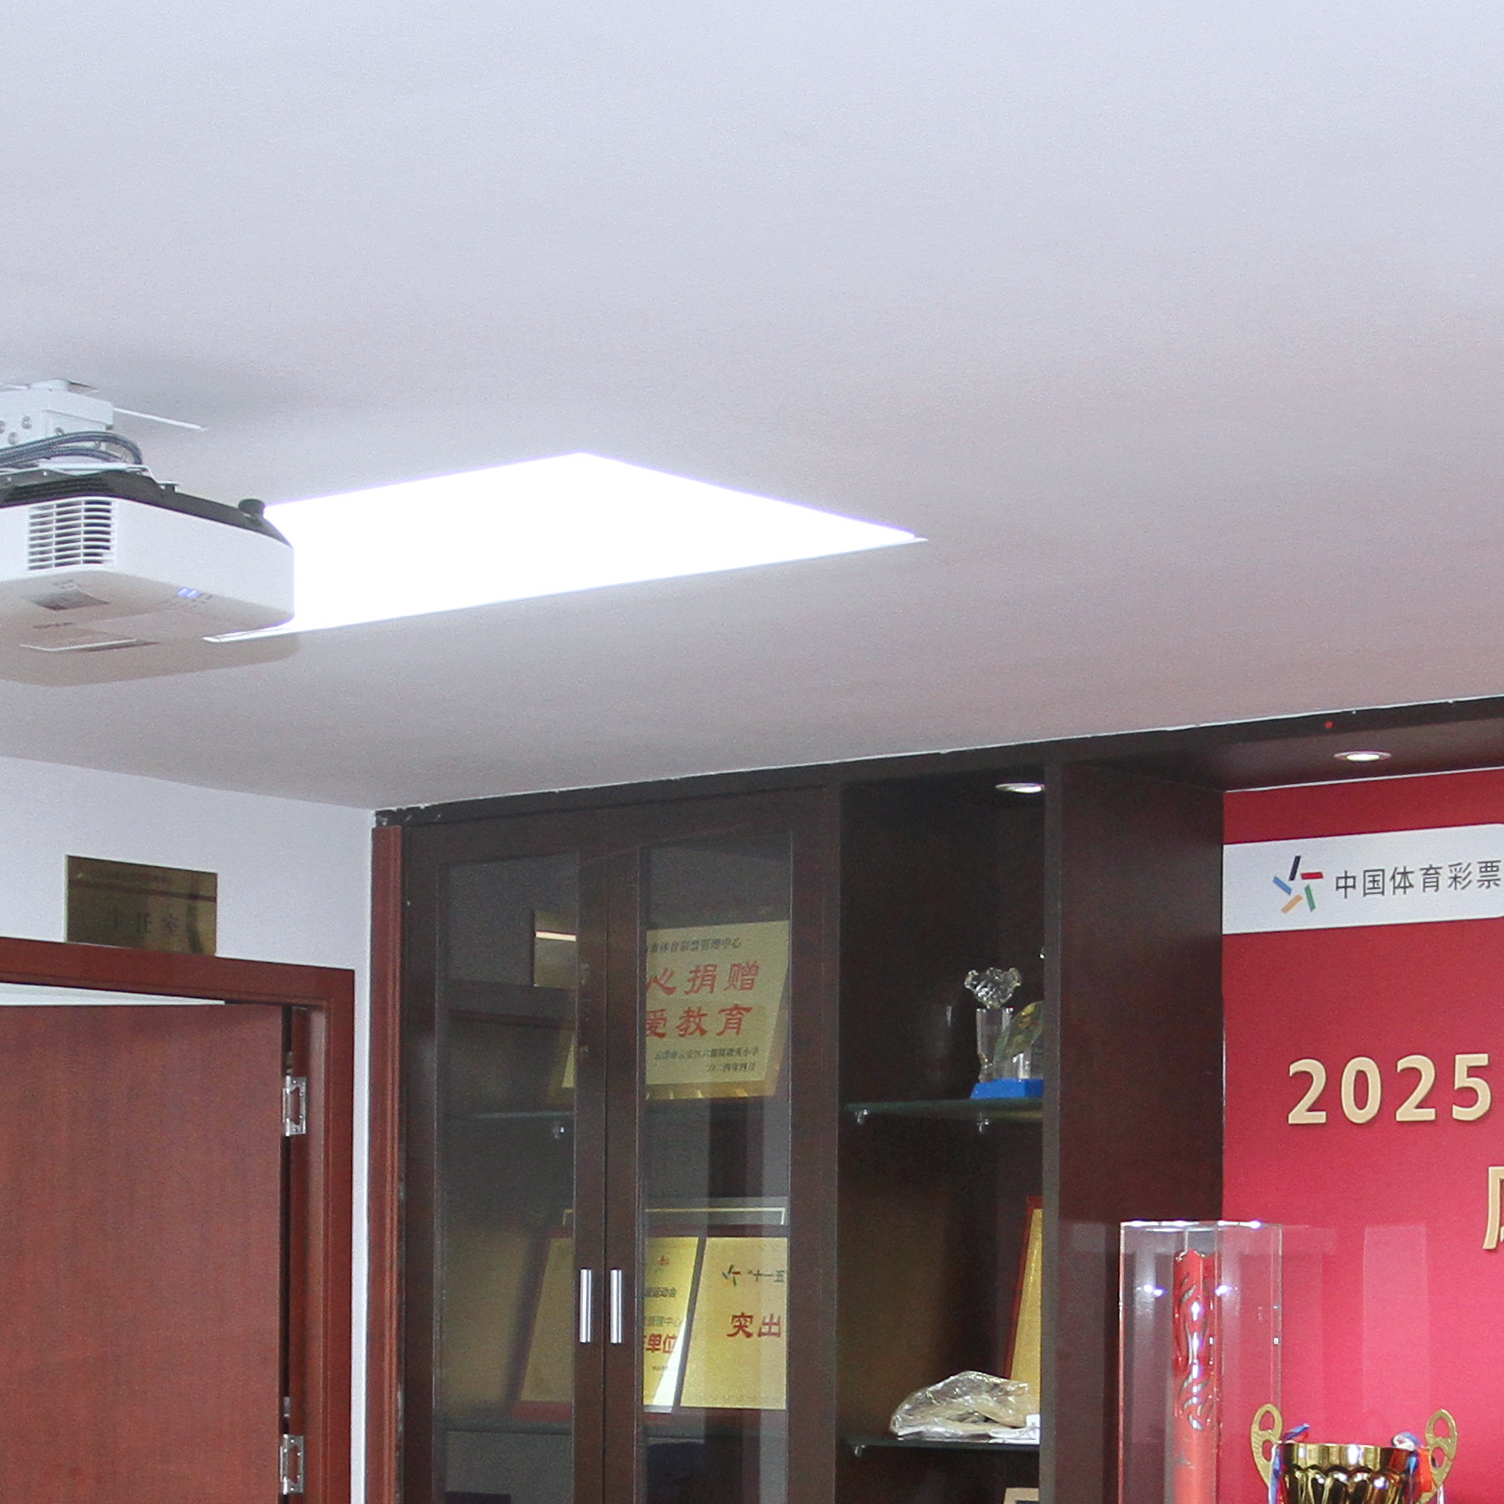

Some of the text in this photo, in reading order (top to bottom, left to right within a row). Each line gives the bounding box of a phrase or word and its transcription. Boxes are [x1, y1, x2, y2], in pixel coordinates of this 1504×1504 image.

[1334, 858, 1502, 899] 中国体育彩票
[726, 1312, 782, 1339] 突出
[643, 1333, 678, 1353] 单位
